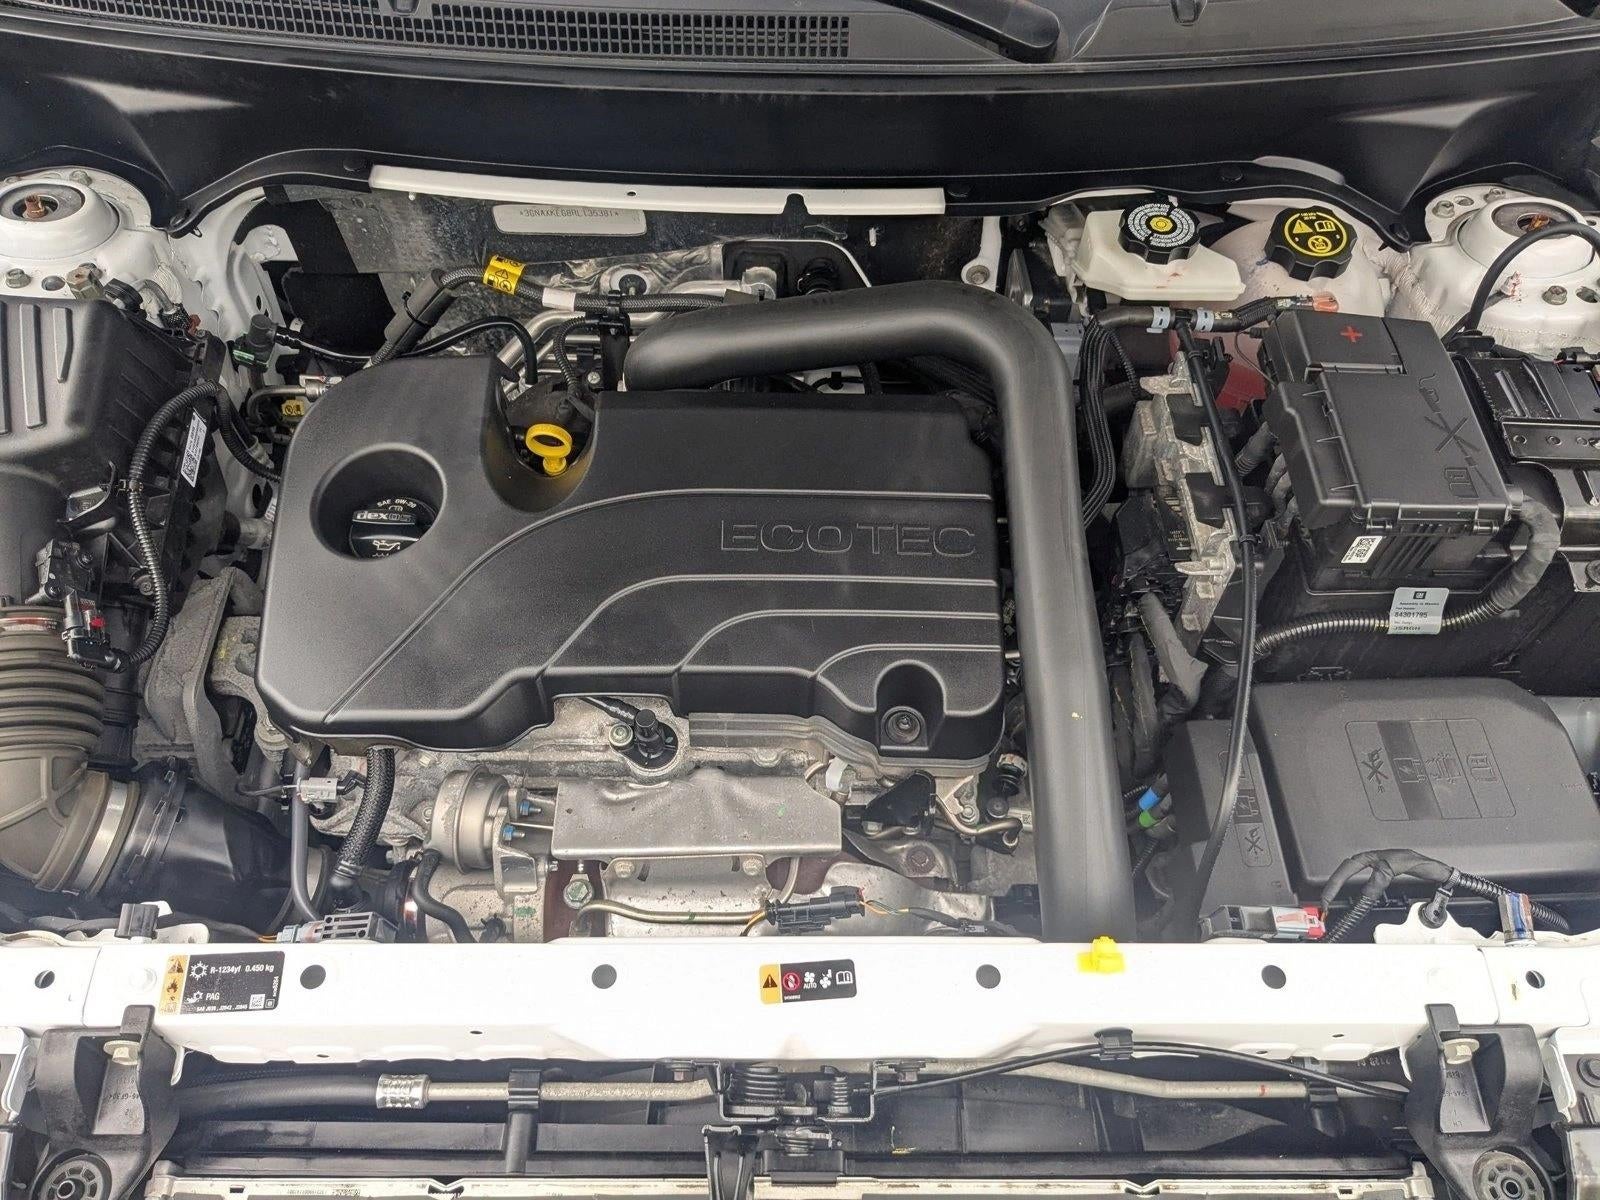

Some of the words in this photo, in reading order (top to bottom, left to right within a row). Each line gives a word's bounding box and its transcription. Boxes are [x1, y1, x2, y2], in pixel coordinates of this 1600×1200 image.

[377, 499, 392, 507] SAE
[395, 498, 417, 508] 0W-20
[356, 510, 414, 522] dexos
[720, 519, 976, 558] ECOTEC
[209, 965, 241, 975] R-1234yf
[245, 964, 264, 972] 0.450
[265, 963, 275, 973] kg
[205, 992, 220, 1001] PAG
